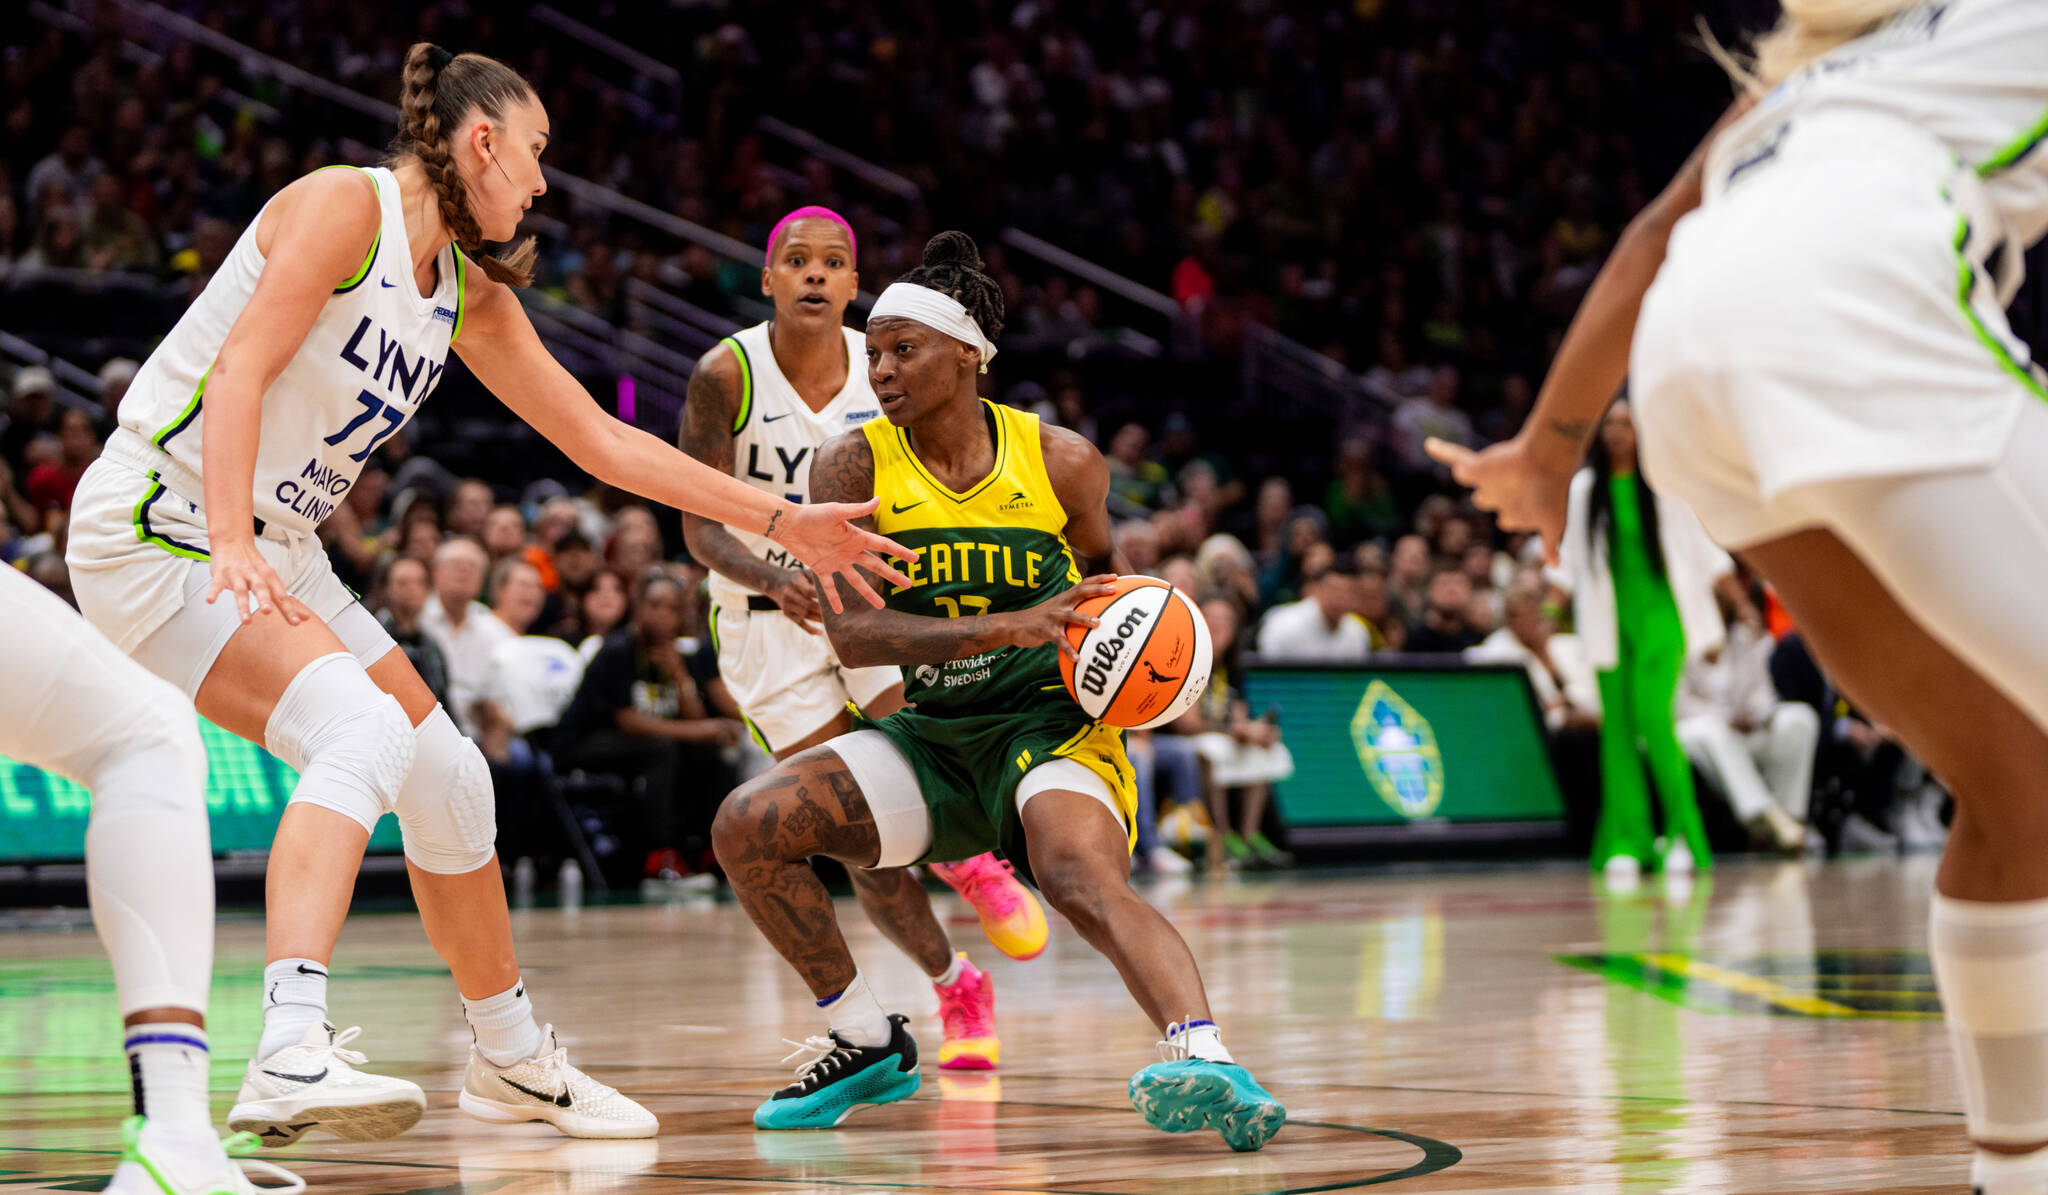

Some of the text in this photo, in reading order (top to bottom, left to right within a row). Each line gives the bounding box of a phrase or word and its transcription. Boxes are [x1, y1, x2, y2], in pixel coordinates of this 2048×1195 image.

[340, 315, 443, 407] LYNX
[323, 388, 406, 463] 77
[300, 458, 350, 496] MAYO
[747, 443, 819, 484] LY
[999, 501, 1034, 511] SYMETRA
[766, 548, 805, 569] MA
[1080, 606, 1150, 697] Wilson
[943, 666, 991, 688] SWEDISH
